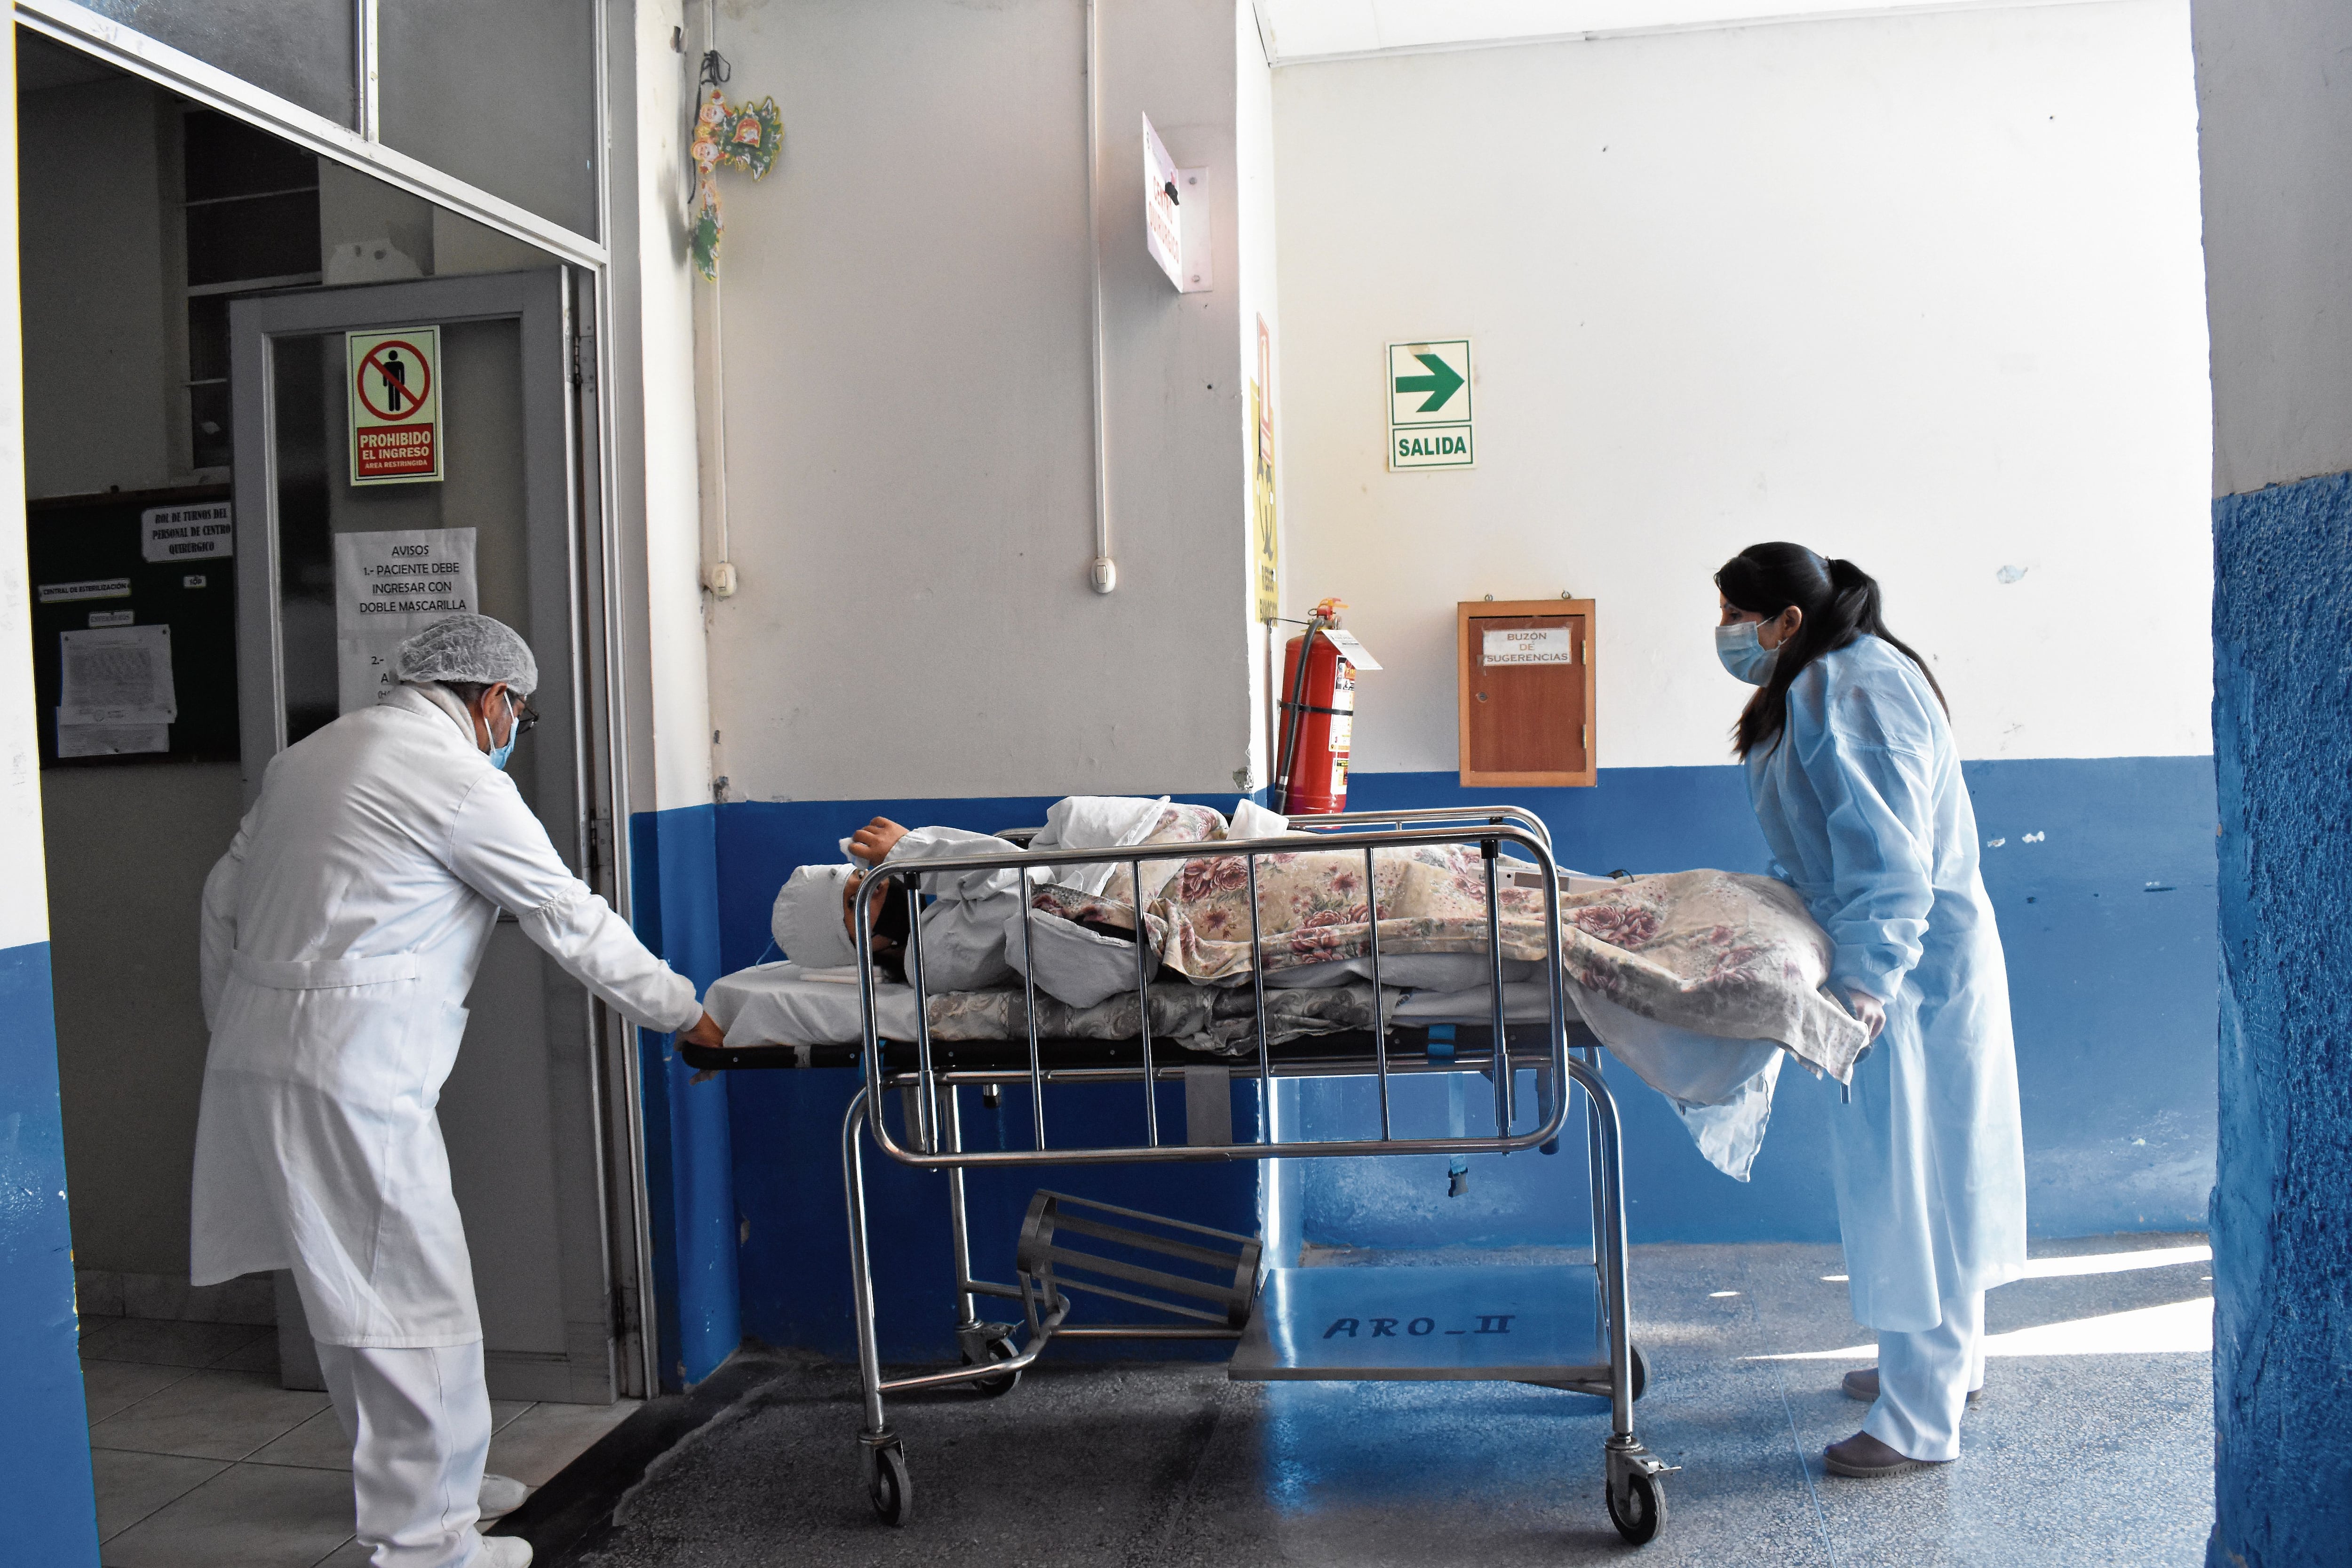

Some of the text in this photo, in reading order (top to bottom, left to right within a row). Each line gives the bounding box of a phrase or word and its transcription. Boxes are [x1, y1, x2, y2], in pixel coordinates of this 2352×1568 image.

[360, 431, 431, 448] PROHIBIDO
[1399, 436, 1467, 456] SALIDA
[363, 446, 429, 460] EL INGRESO
[384, 459, 428, 468] RESTRINGIDA
[172, 512, 181, 522] DE
[183, 509, 211, 521] TURNOS
[213, 508, 227, 519] DEL
[152, 524, 231, 540] PERSONAL DE CENTRO
[392, 545, 429, 556] AVISOS
[377, 564, 429, 575] PACIENTE
[432, 562, 459, 573] DEBE
[373, 581, 452, 594] INGRESAR CON
[360, 600, 467, 612] DOBLE MASCARILLA
[1507, 631, 1547, 640] BUZÓN
[371, 656, 384, 665] 2.-
[1487, 653, 1568, 662] SUGERENCIAS
